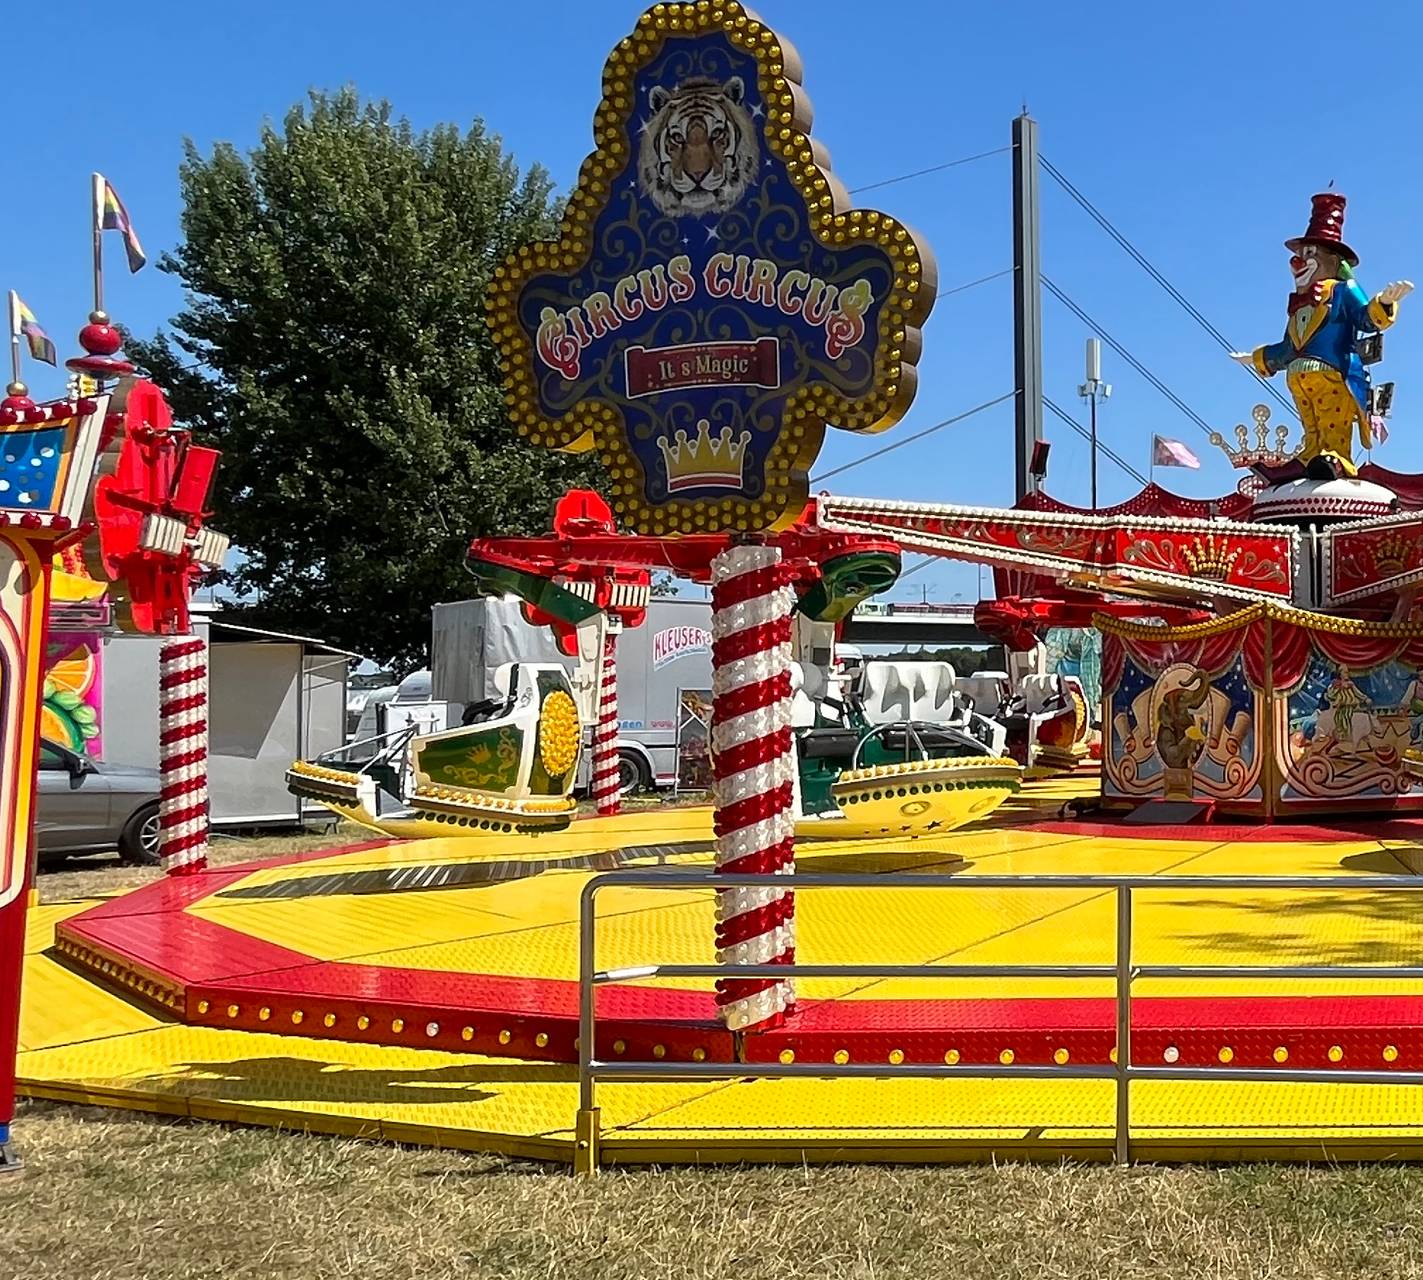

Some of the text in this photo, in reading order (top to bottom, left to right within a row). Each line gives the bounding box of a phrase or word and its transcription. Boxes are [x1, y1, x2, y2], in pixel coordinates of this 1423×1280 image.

[537, 252, 875, 380] CIRCUS CIRCUS
[696, 354, 748, 379] Magic
